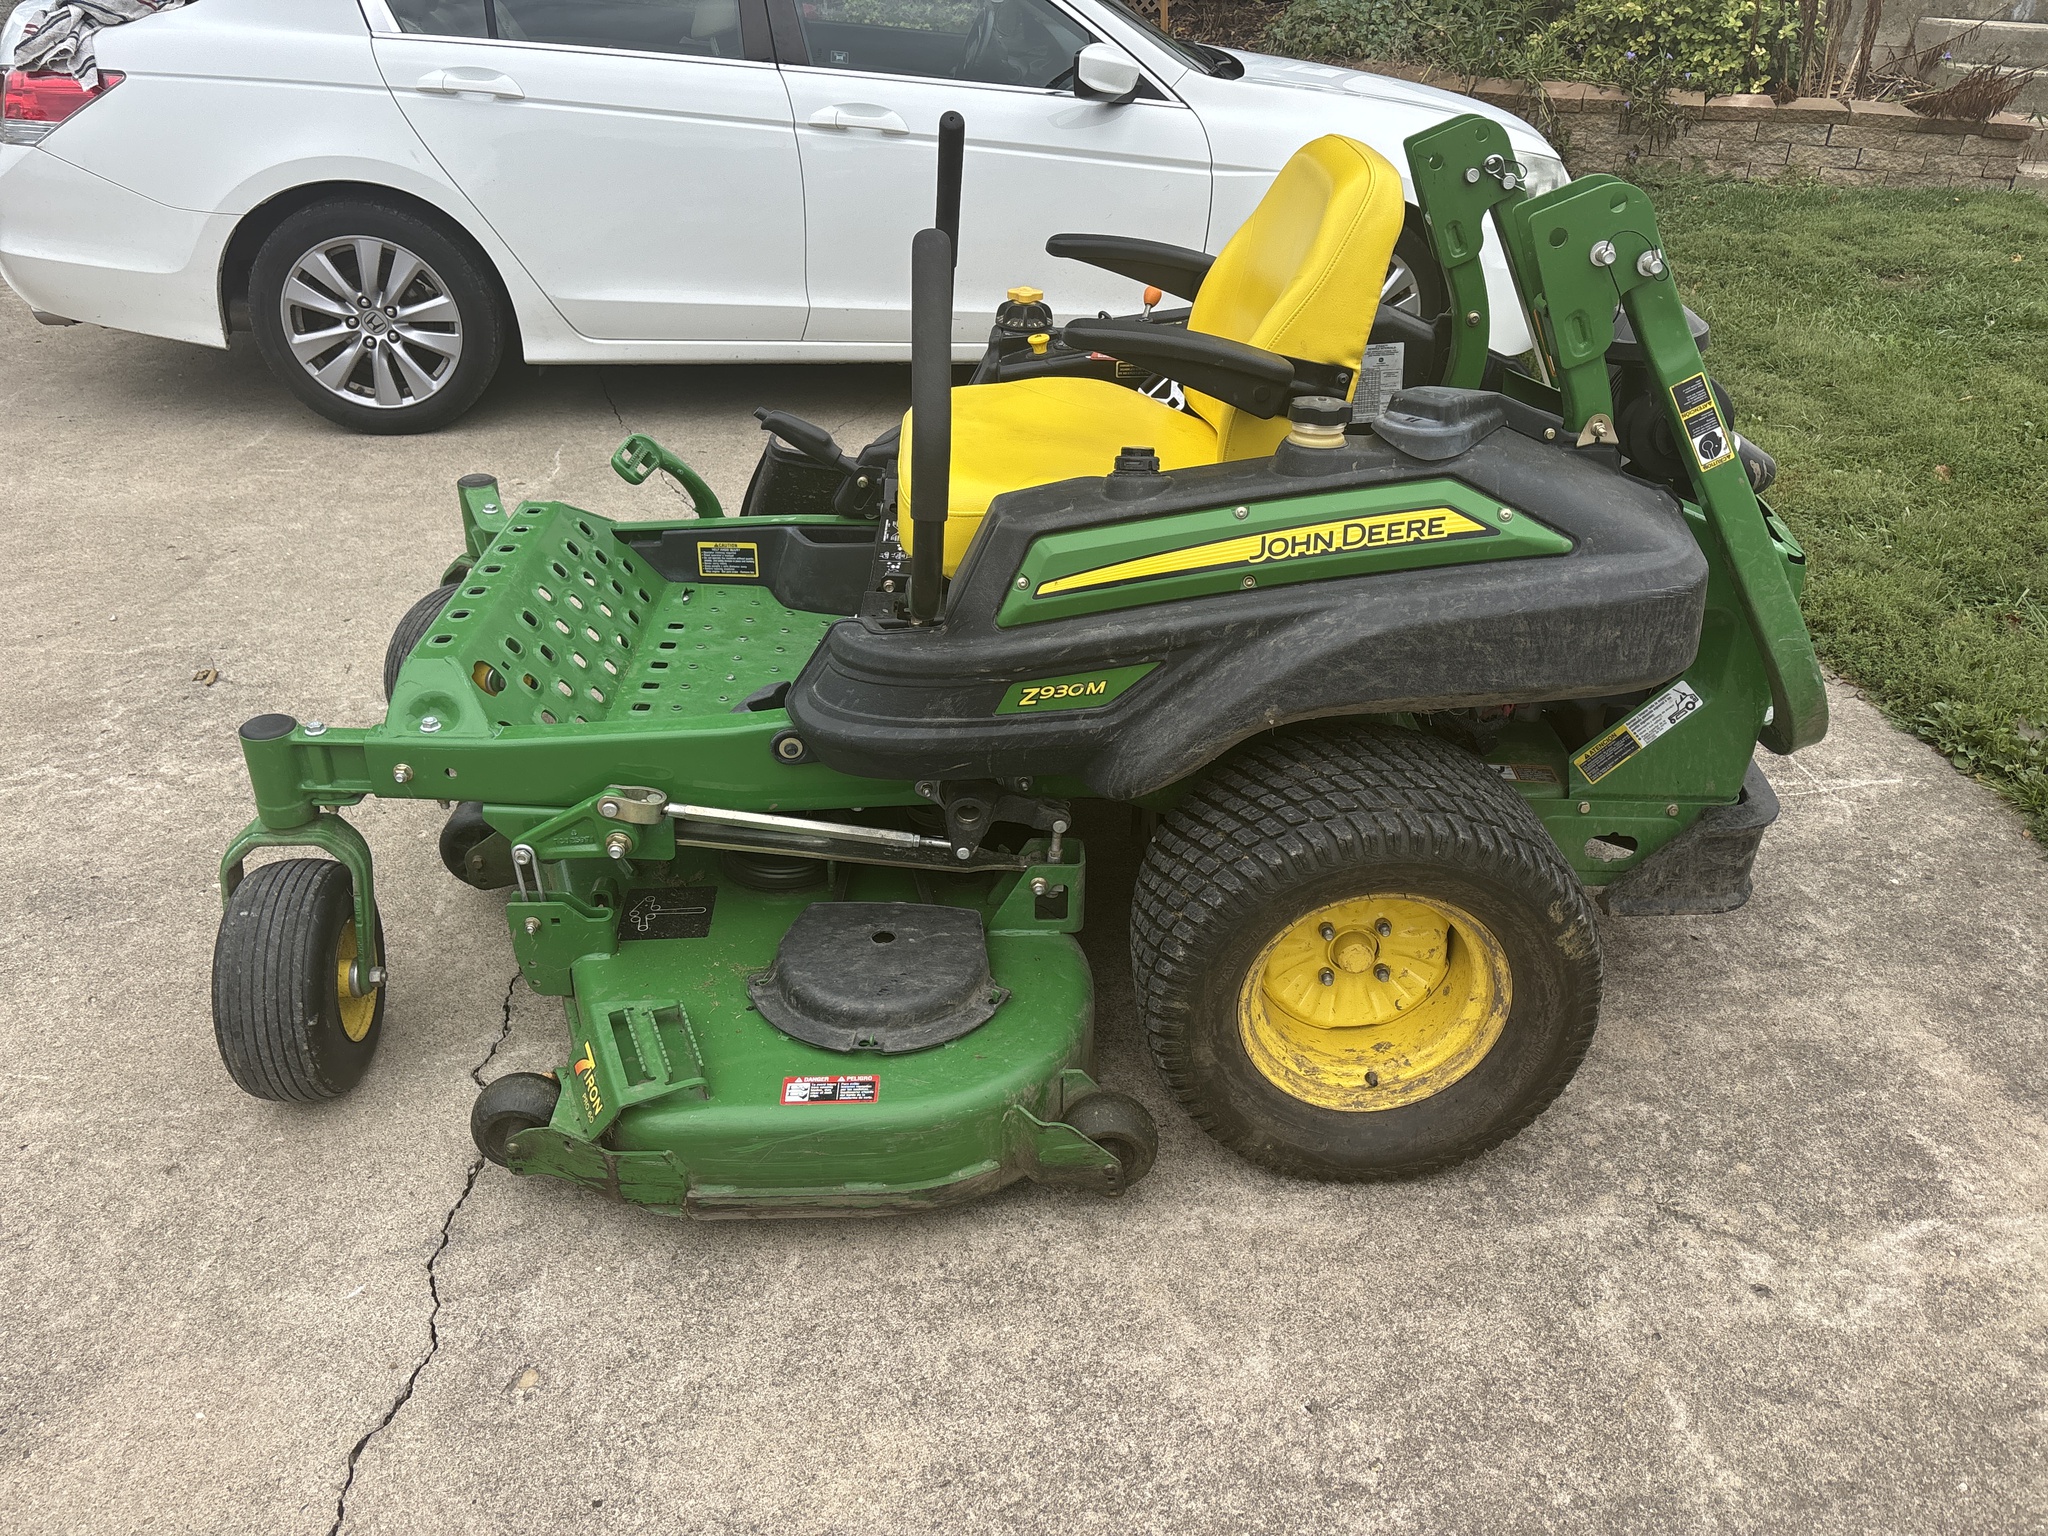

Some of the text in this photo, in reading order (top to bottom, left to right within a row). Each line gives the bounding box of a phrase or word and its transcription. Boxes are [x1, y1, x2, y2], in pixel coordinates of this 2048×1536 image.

[1702, 456, 1728, 470] CAUTION
[1249, 516, 1447, 560] JOHN DEERE
[1018, 680, 1107, 706] Z930M
[582, 1092, 595, 1124] PRO 60
